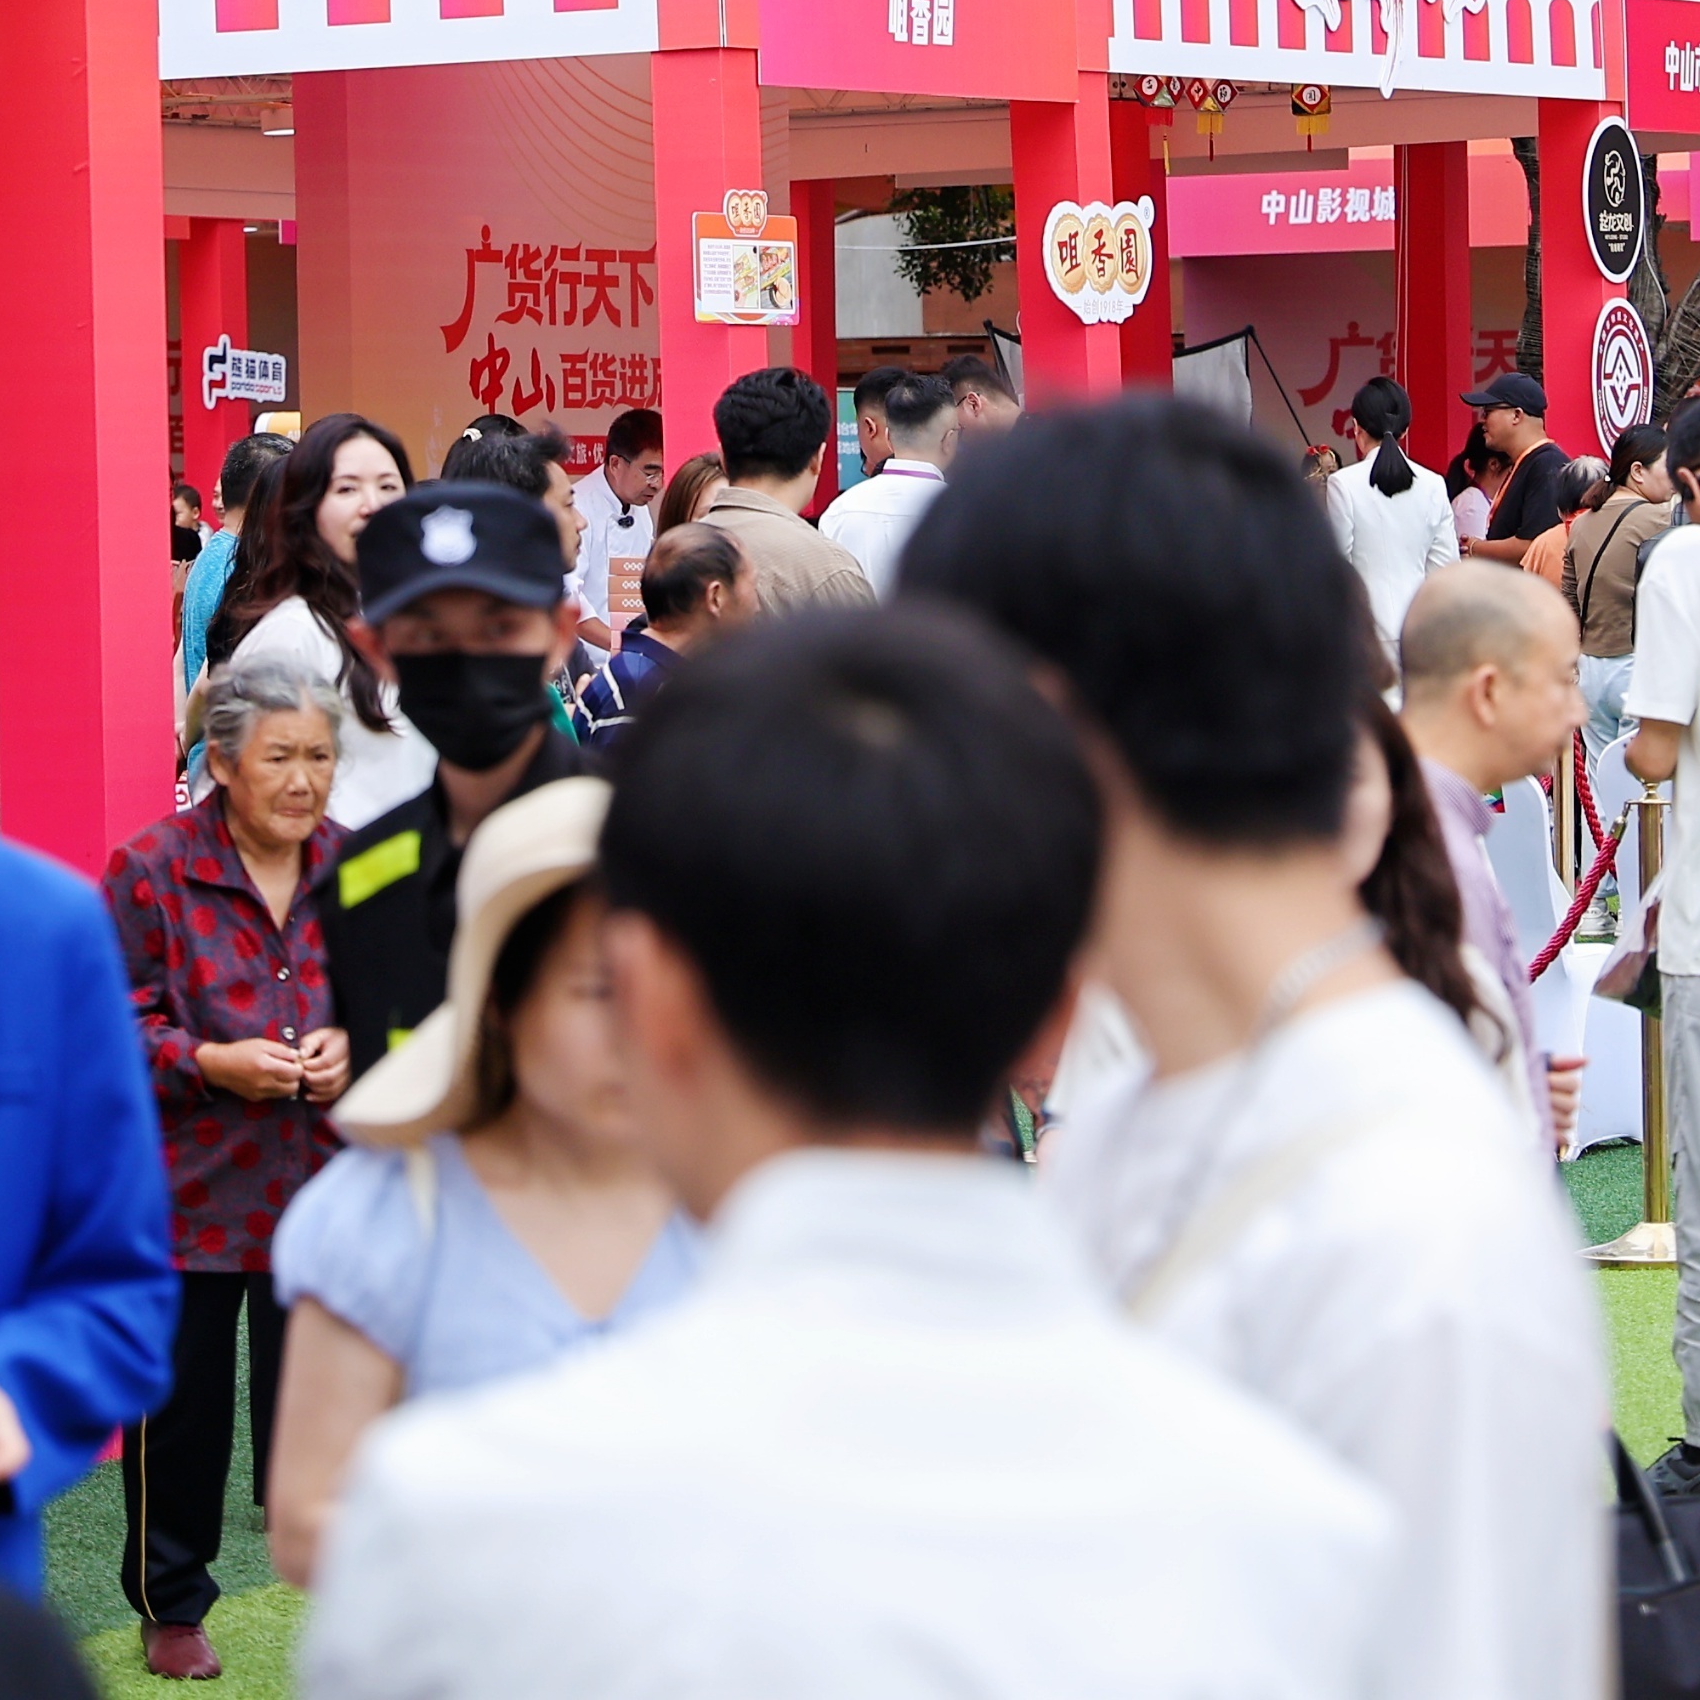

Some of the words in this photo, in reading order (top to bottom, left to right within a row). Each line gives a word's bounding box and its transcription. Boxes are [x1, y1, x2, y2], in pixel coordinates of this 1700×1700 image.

[1261, 186, 1395, 225] 中山影视城
[1057, 228, 1140, 280] 咀香園
[440, 224, 657, 354] 广货行天下
[231, 356, 283, 382] 熊猫体育
